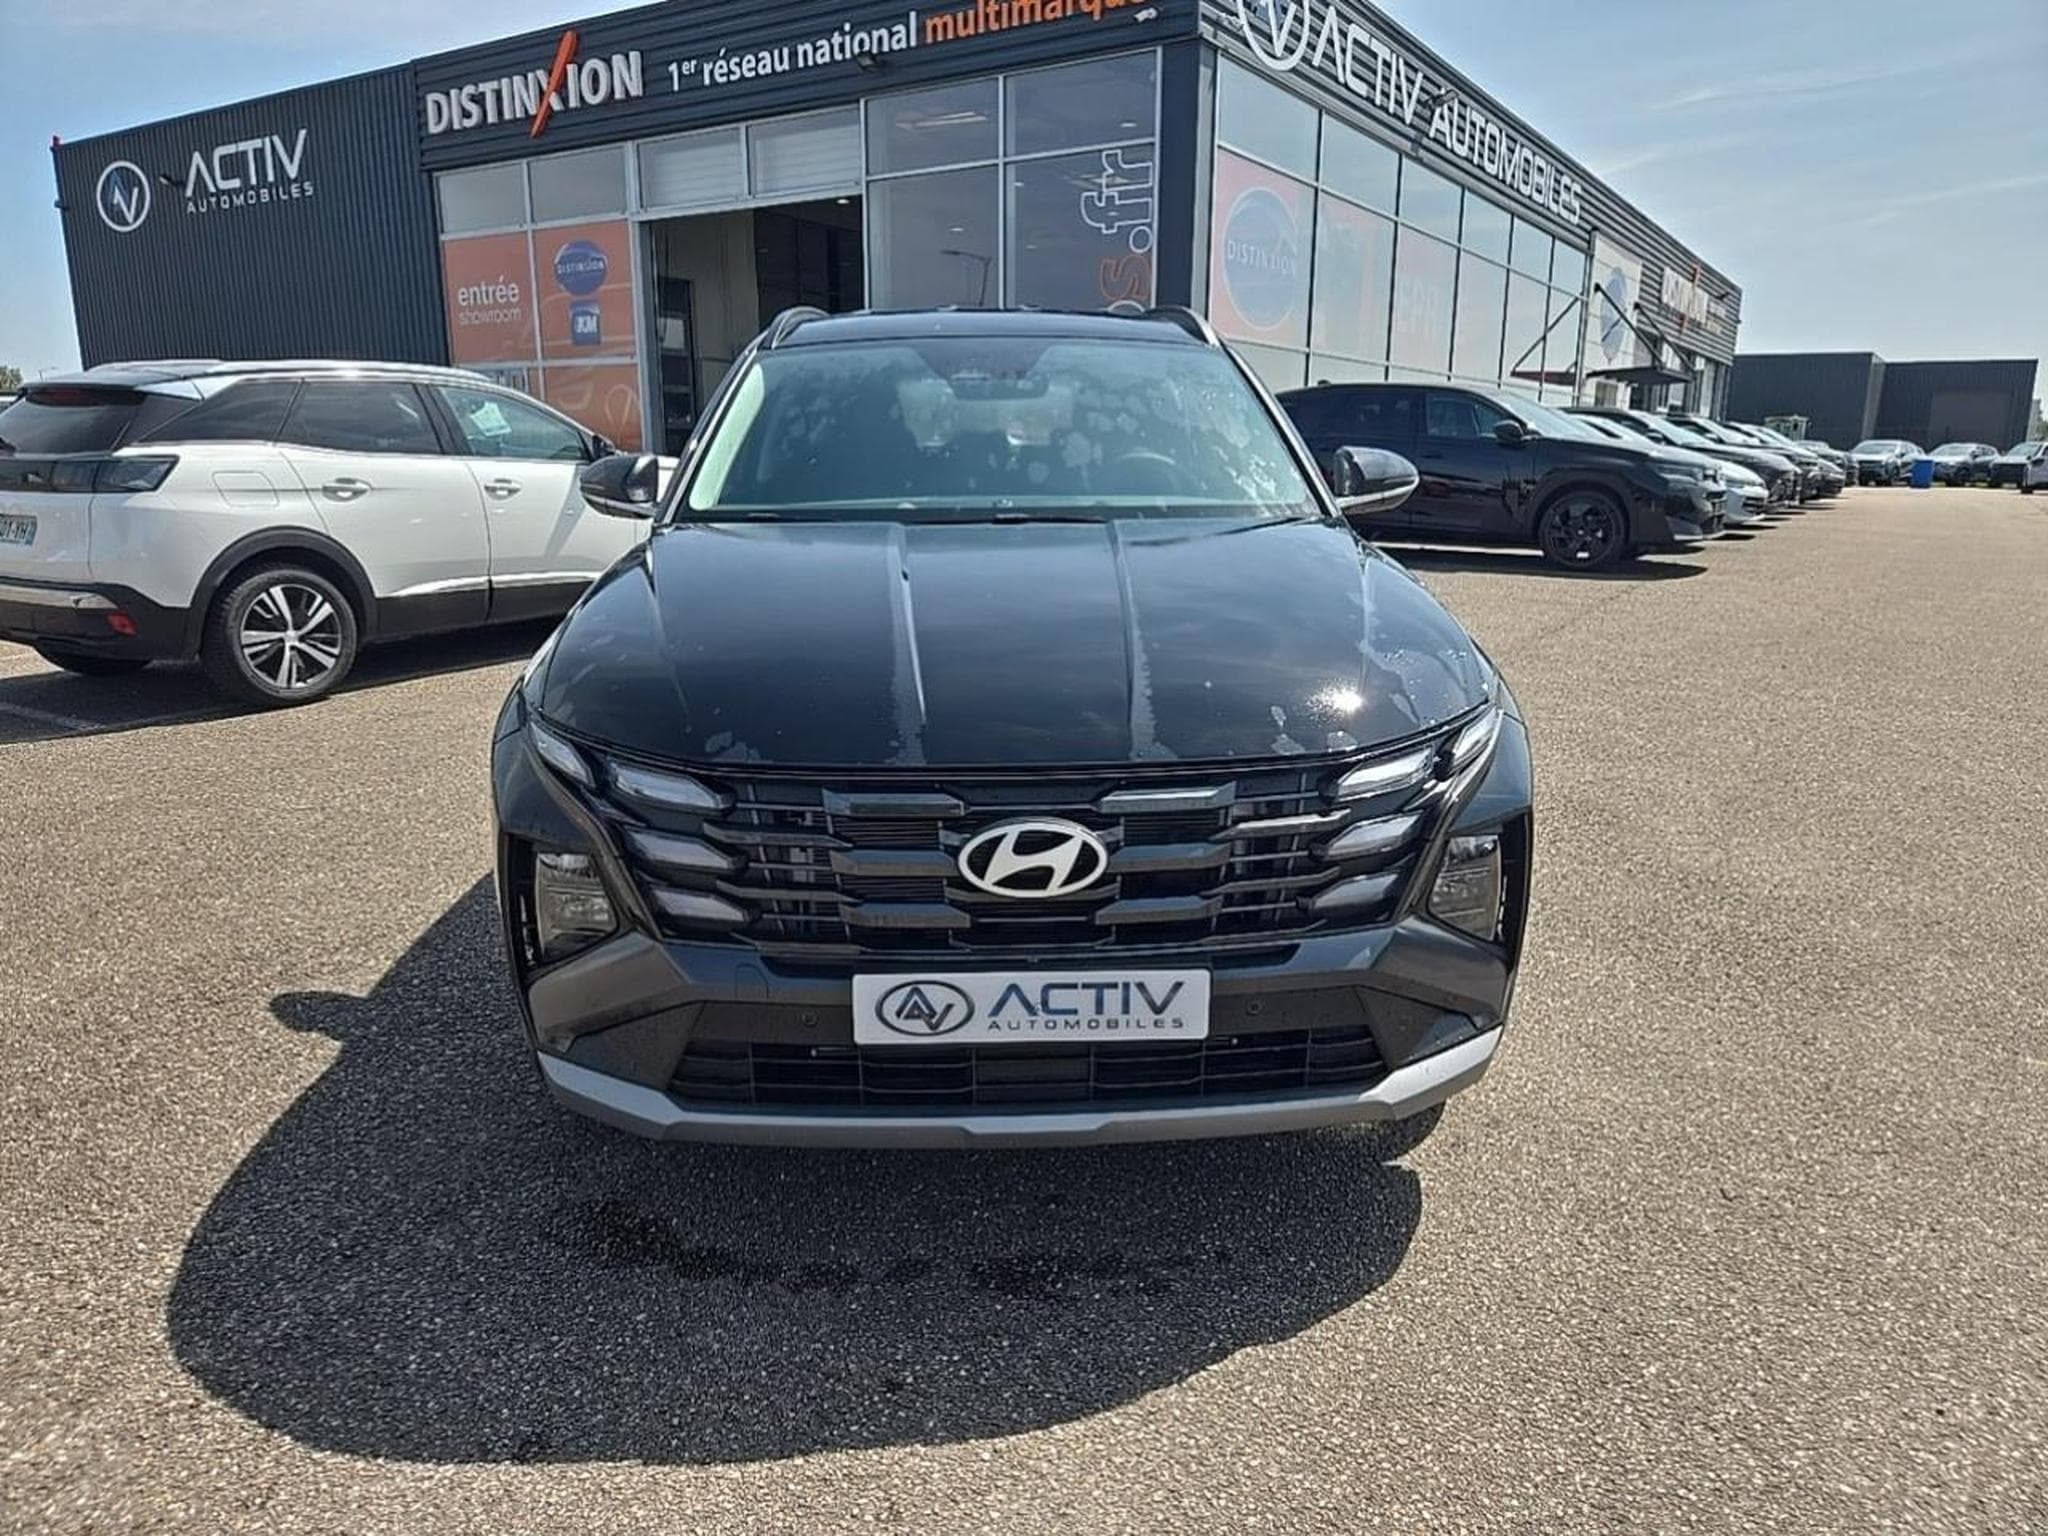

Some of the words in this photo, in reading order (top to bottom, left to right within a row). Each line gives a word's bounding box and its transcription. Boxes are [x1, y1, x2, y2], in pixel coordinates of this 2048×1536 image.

[703, 46, 789, 86] réseau
[796, 10, 917, 69] national
[1311, 5, 1424, 125] ACTIV
[426, 30, 644, 138] DISTINXION
[185, 129, 308, 197] ACTIV
[1429, 92, 1582, 225] AUTOMOBILES
[186, 180, 314, 215] AUTOMOBILES
[457, 275, 520, 307] entrée
[459, 306, 521, 327] showroom
[987, 980, 1185, 1017] ACTIV
[987, 1017, 1184, 1031] AUTOMOBILES
